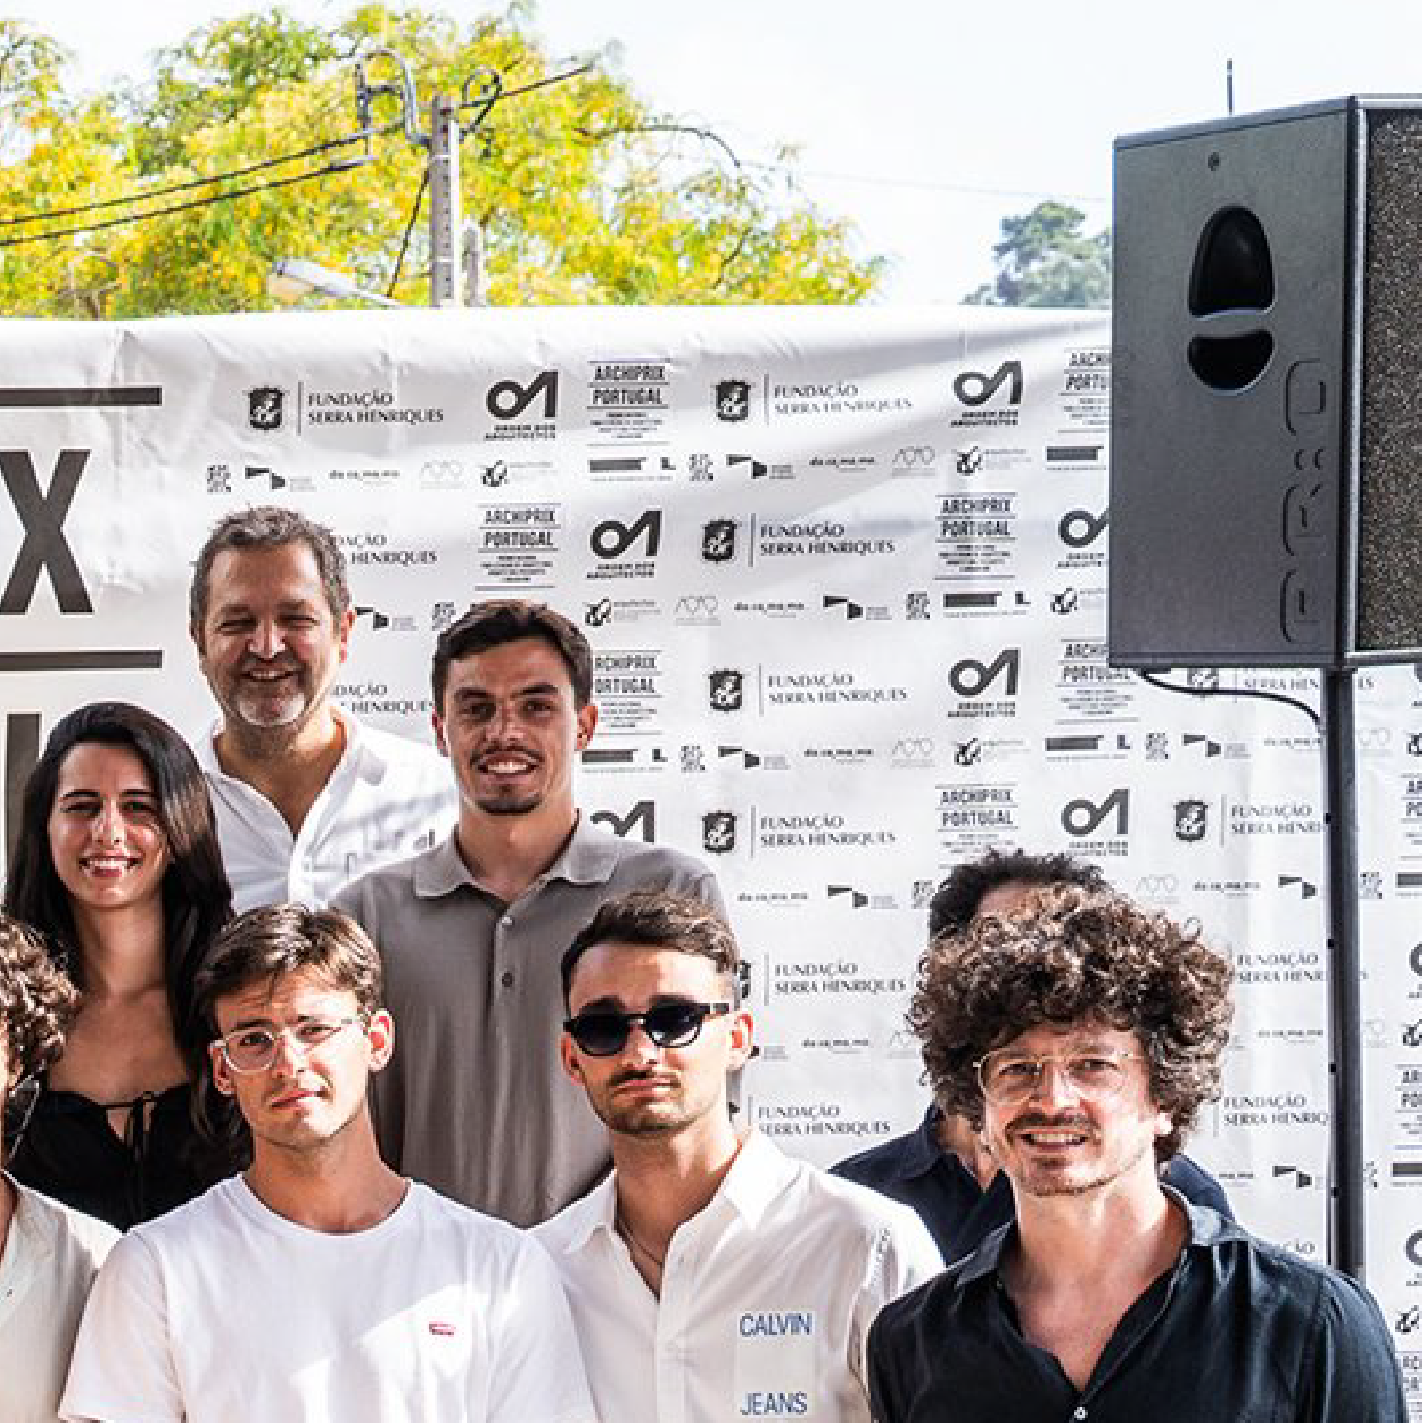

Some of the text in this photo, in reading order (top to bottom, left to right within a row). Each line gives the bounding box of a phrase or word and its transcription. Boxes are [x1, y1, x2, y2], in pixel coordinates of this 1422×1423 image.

[1069, 353, 1109, 365] ARCHI
[595, 365, 666, 381] ARCHIPRIX
[1066, 374, 1109, 389] PORTU
[594, 389, 661, 404] PORTUGAL
[941, 500, 1012, 514] ARCHIPRIX
[485, 510, 554, 524] ARCHIPRIX
[941, 521, 1010, 536] PORTUGAL
[485, 531, 553, 546] PORTUGAL
[1066, 645, 1109, 658] ARCHI
[595, 656, 655, 669] RCHIPRIX
[595, 678, 655, 693] ORTUGAL
[940, 789, 1012, 802] ARCHIPRIX
[942, 810, 1012, 825] PORTUGAL
[1271, 1111, 1328, 1128] HENRIQ
[740, 1314, 812, 1336] CALVIN
[740, 1393, 808, 1415] JEANS
